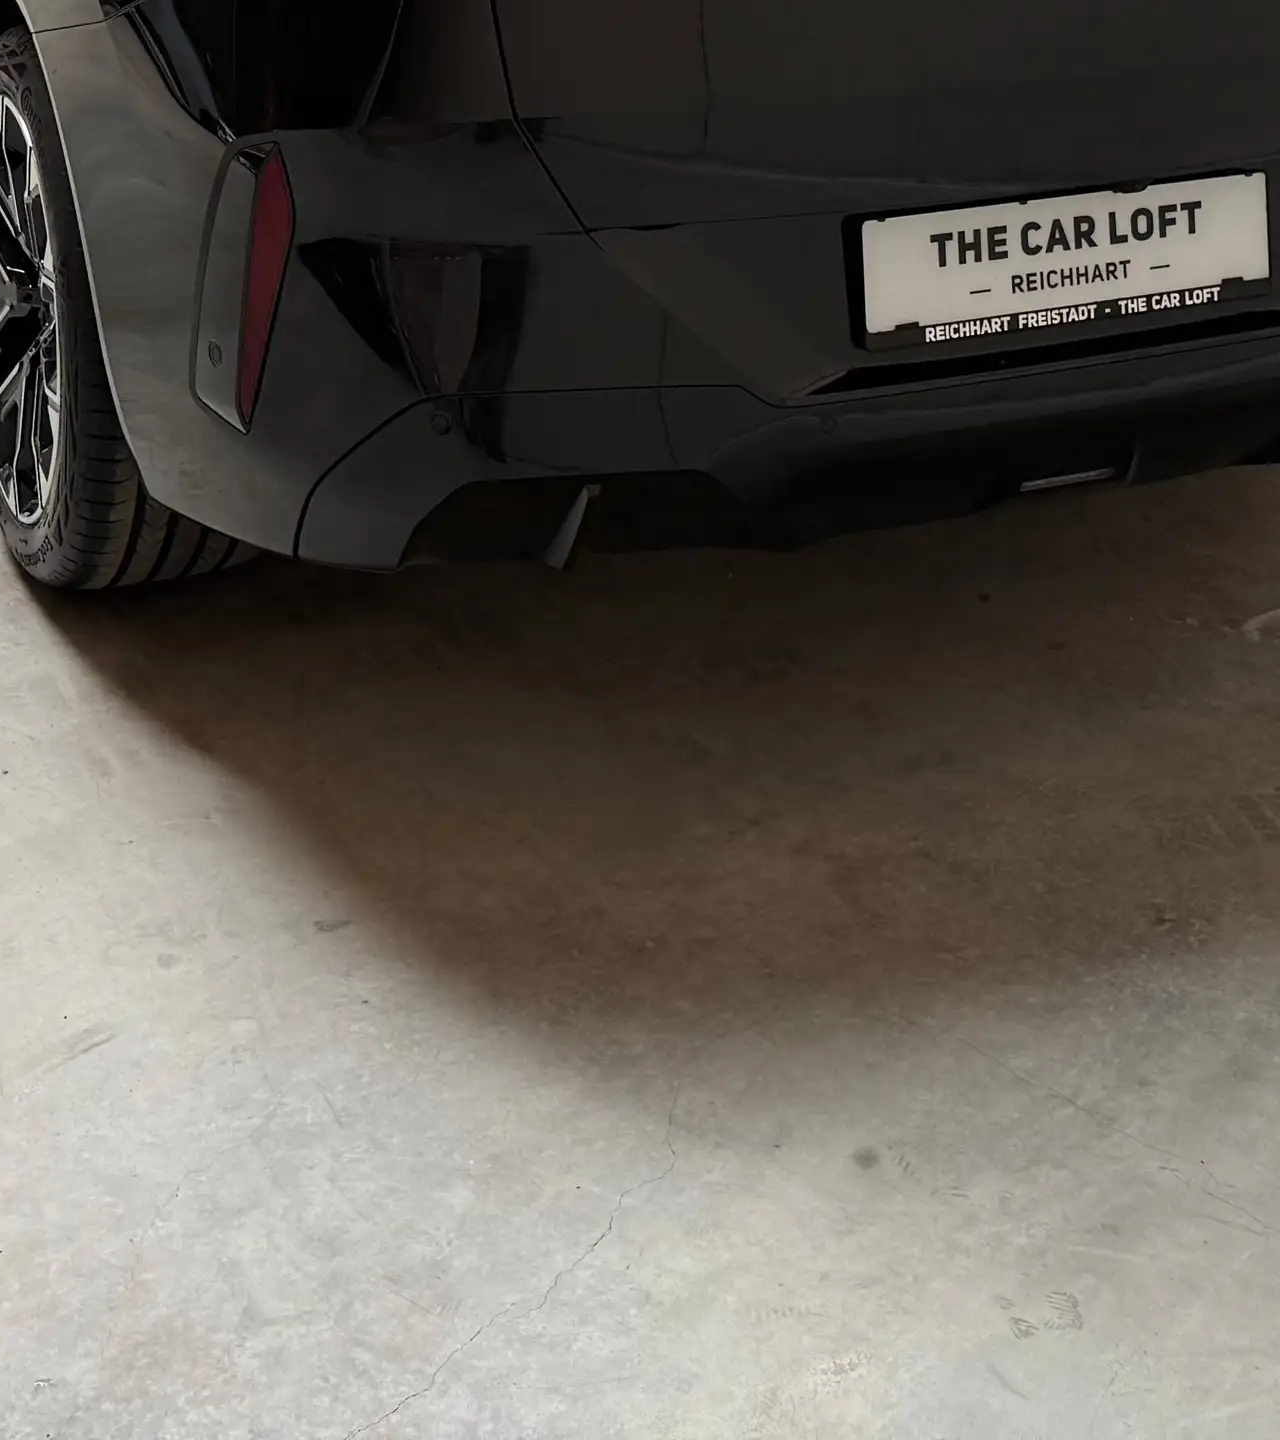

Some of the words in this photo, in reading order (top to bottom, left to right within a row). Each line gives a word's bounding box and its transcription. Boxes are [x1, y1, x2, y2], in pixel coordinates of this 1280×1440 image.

[929, 224, 1009, 268] THE
[1020, 215, 1099, 256] CAR
[1108, 200, 1202, 246] LOFT
[1011, 260, 1131, 294] REICHHART
[925, 316, 1011, 343] REICHHART
[1018, 304, 1098, 329] FREISTADT
[1117, 297, 1148, 315] THE
[1151, 292, 1181, 310] CAR
[1184, 286, 1221, 306] LOFT
